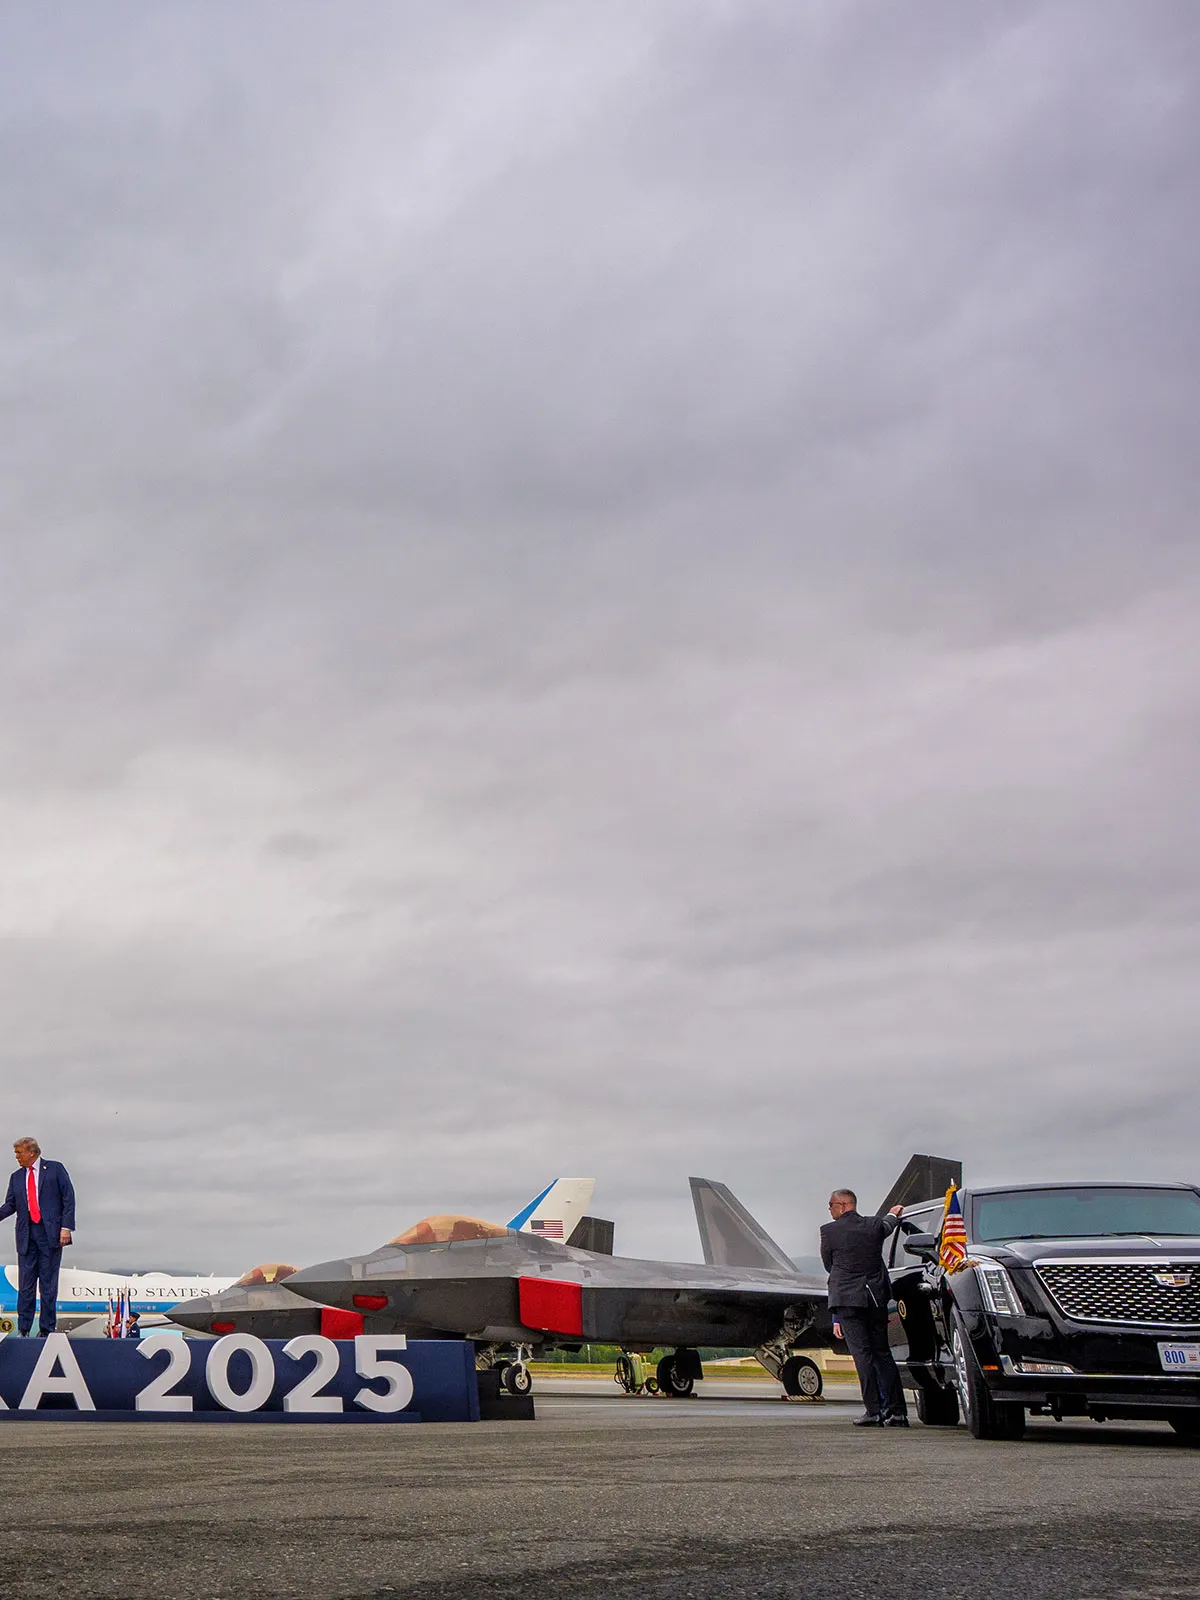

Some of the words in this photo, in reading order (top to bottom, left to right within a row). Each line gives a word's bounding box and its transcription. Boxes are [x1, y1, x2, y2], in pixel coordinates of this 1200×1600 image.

[145, 1287, 210, 1297] STATES
[1164, 1350, 1186, 1364] 800
[135, 1333, 414, 1413] 2025
